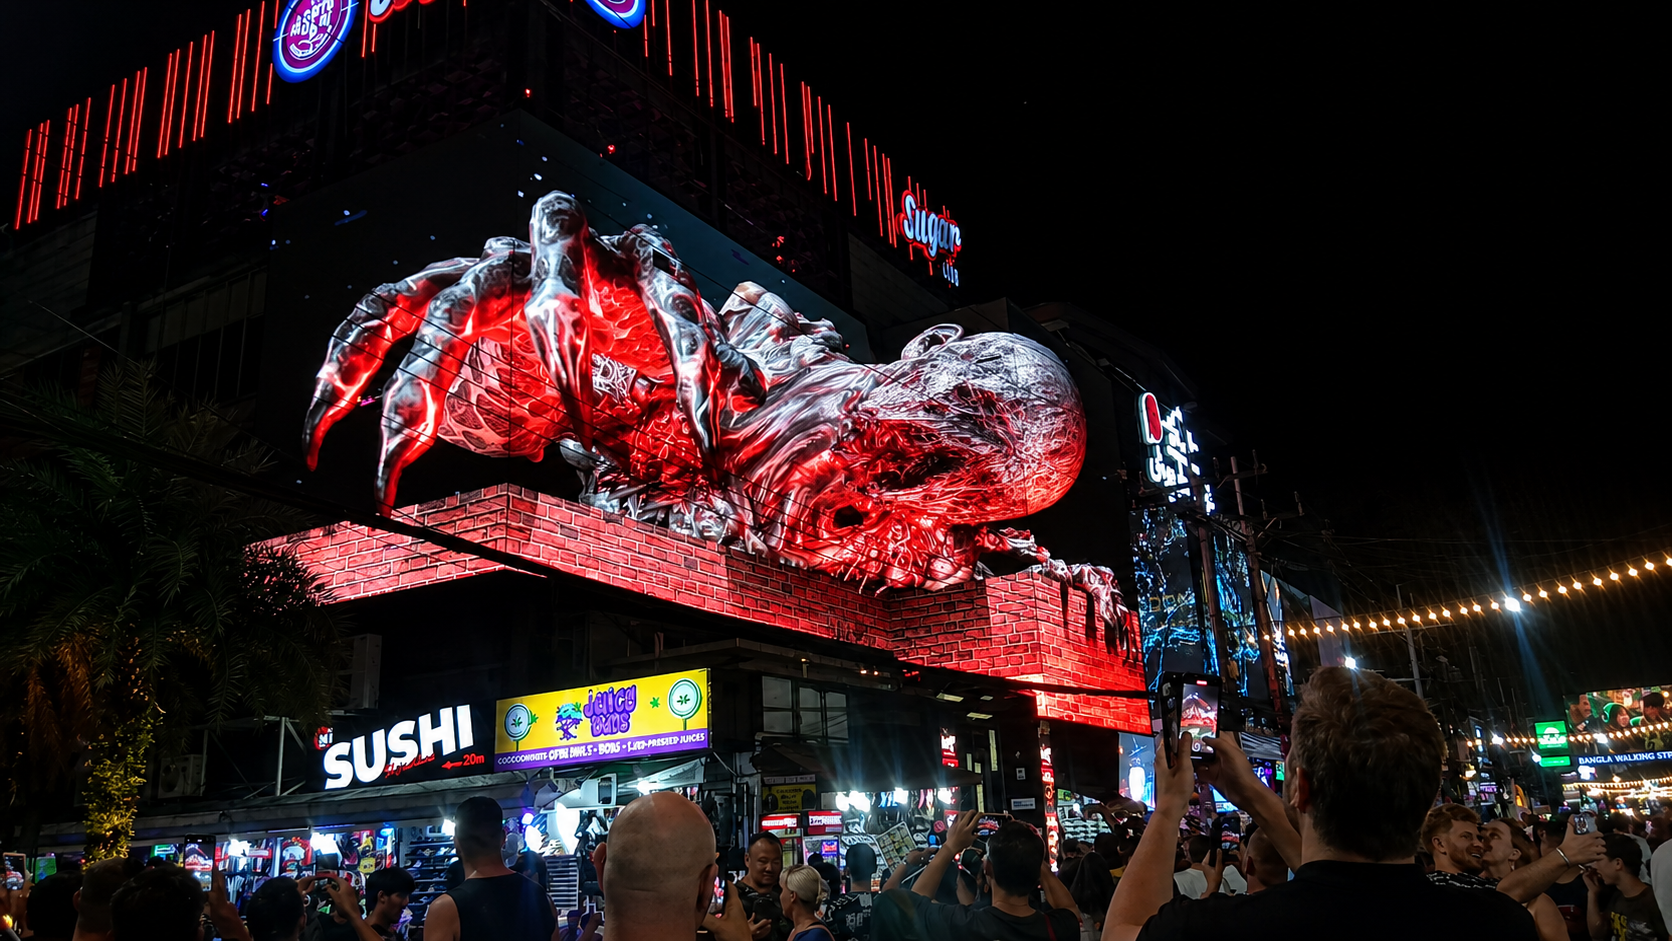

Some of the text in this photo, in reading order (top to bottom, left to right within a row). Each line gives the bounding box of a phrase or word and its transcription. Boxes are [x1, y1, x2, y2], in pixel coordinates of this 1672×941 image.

[903, 194, 962, 258] Sugar
[679, 732, 705, 744] JUICES
[323, 704, 474, 790] SUSHI
[462, 753, 485, 767] 20m
[1578, 755, 1613, 765] BANGLA
[1614, 752, 1656, 763] WALKING
